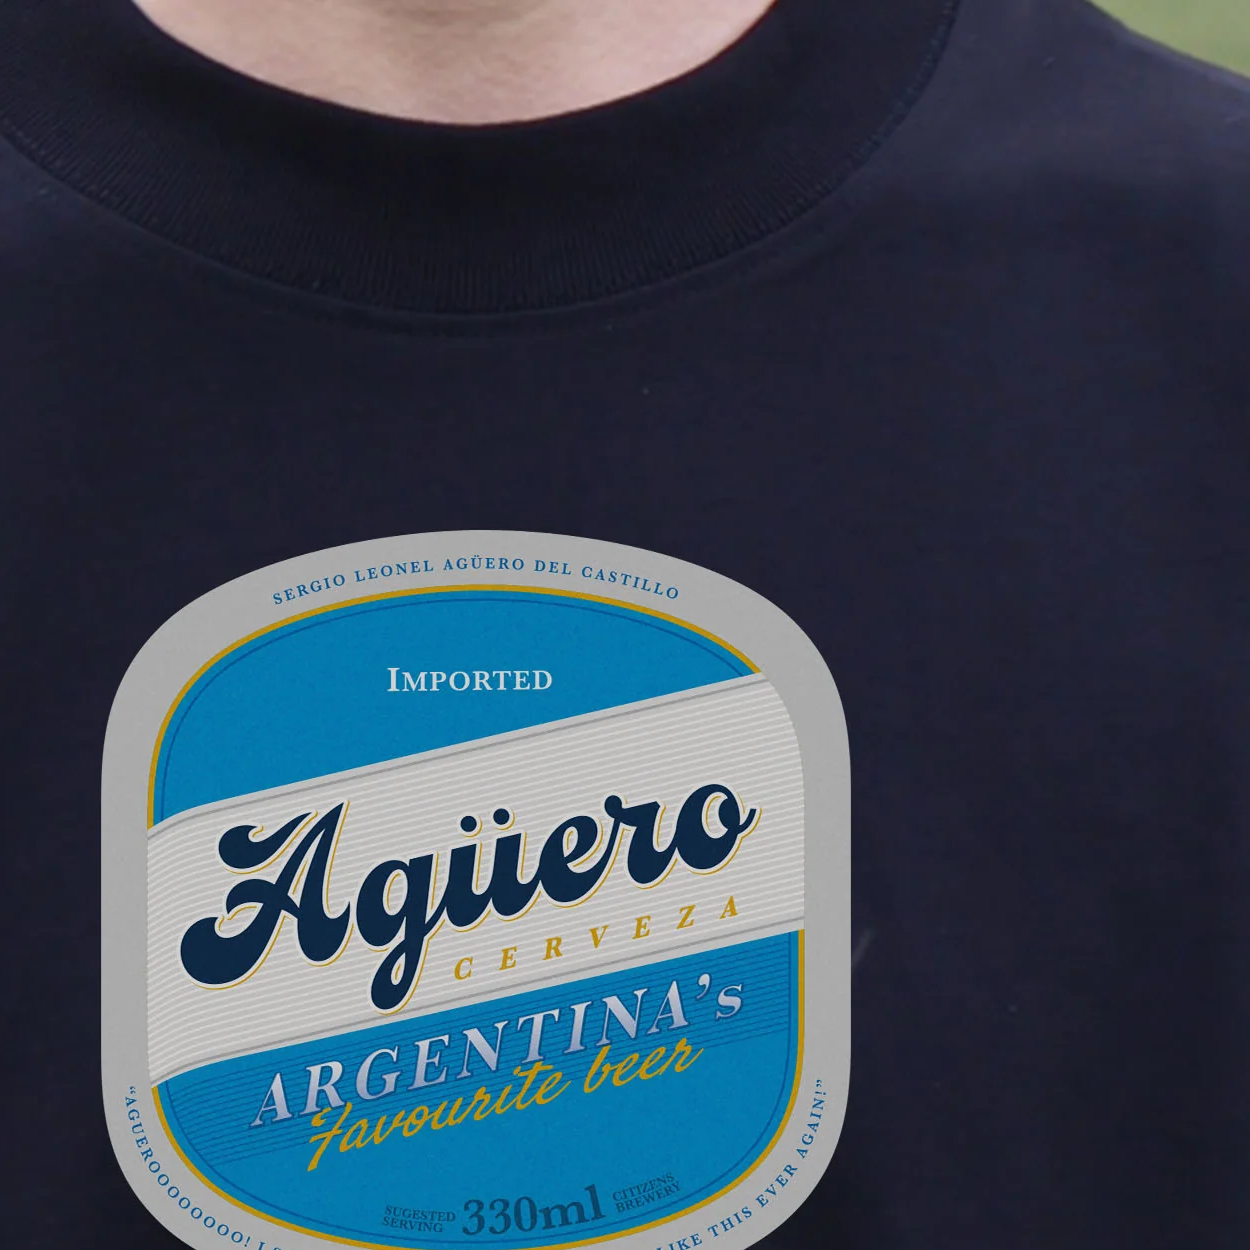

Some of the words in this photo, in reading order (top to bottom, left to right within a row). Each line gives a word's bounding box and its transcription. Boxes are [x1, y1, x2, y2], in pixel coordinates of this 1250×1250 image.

[273, 574, 346, 605] SERGIO
[354, 560, 434, 582] LEONEL
[443, 555, 525, 570] AGÜERO
[534, 559, 572, 575] DEL
[581, 566, 679, 600] CASTILLO
[179, 783, 762, 1013] Agüero
[453, 895, 739, 980] CERVEZA
[583, 1037, 706, 1093] beer
[462, 1184, 607, 1236] 330ml
[612, 1172, 676, 1202] CITIZENS
[615, 1181, 681, 1213] BREWERY
[707, 1206, 753, 1237] THIS
[755, 1164, 798, 1207] EVER
[382, 1216, 444, 1233] SERVING
[384, 1205, 456, 1222] SUGESTED
